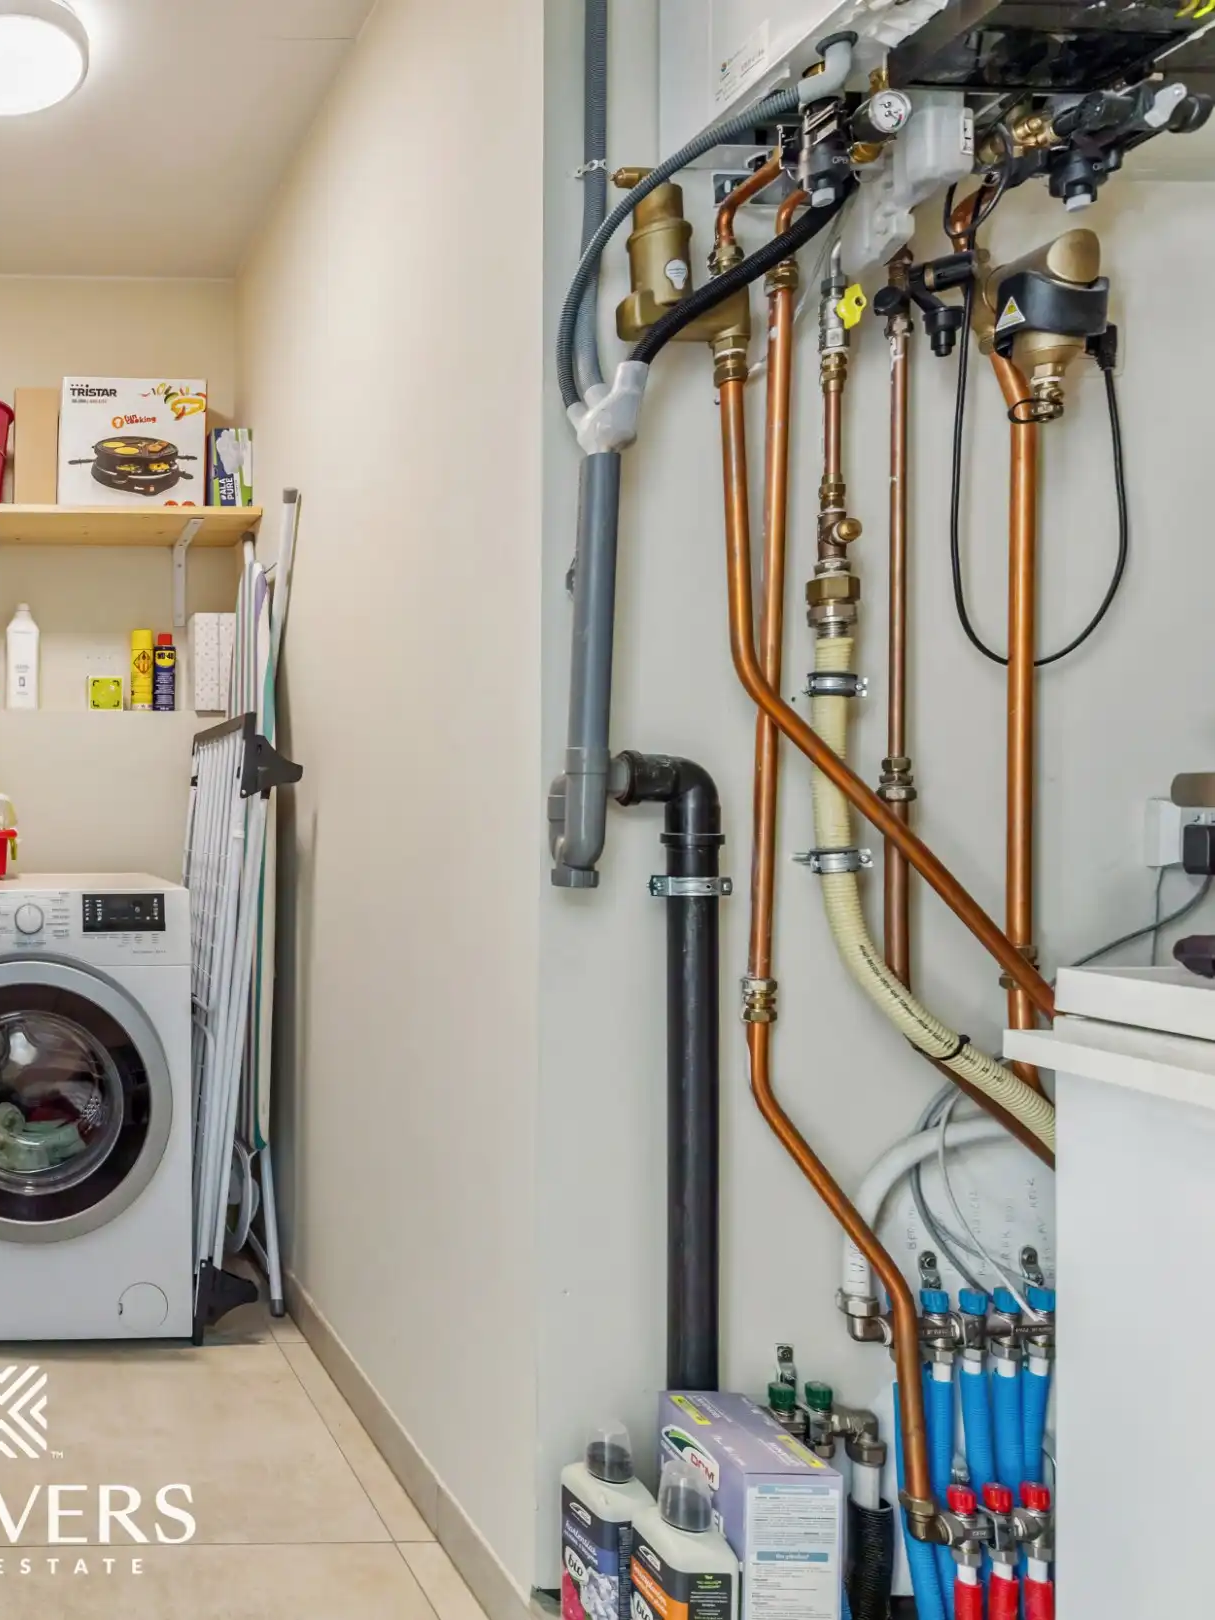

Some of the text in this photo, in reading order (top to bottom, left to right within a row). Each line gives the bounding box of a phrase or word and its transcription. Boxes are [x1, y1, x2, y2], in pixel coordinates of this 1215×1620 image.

[226, 477, 235, 500] PURE
[157, 652, 174, 660] WD-40
[567, 1554, 584, 1578] bio
